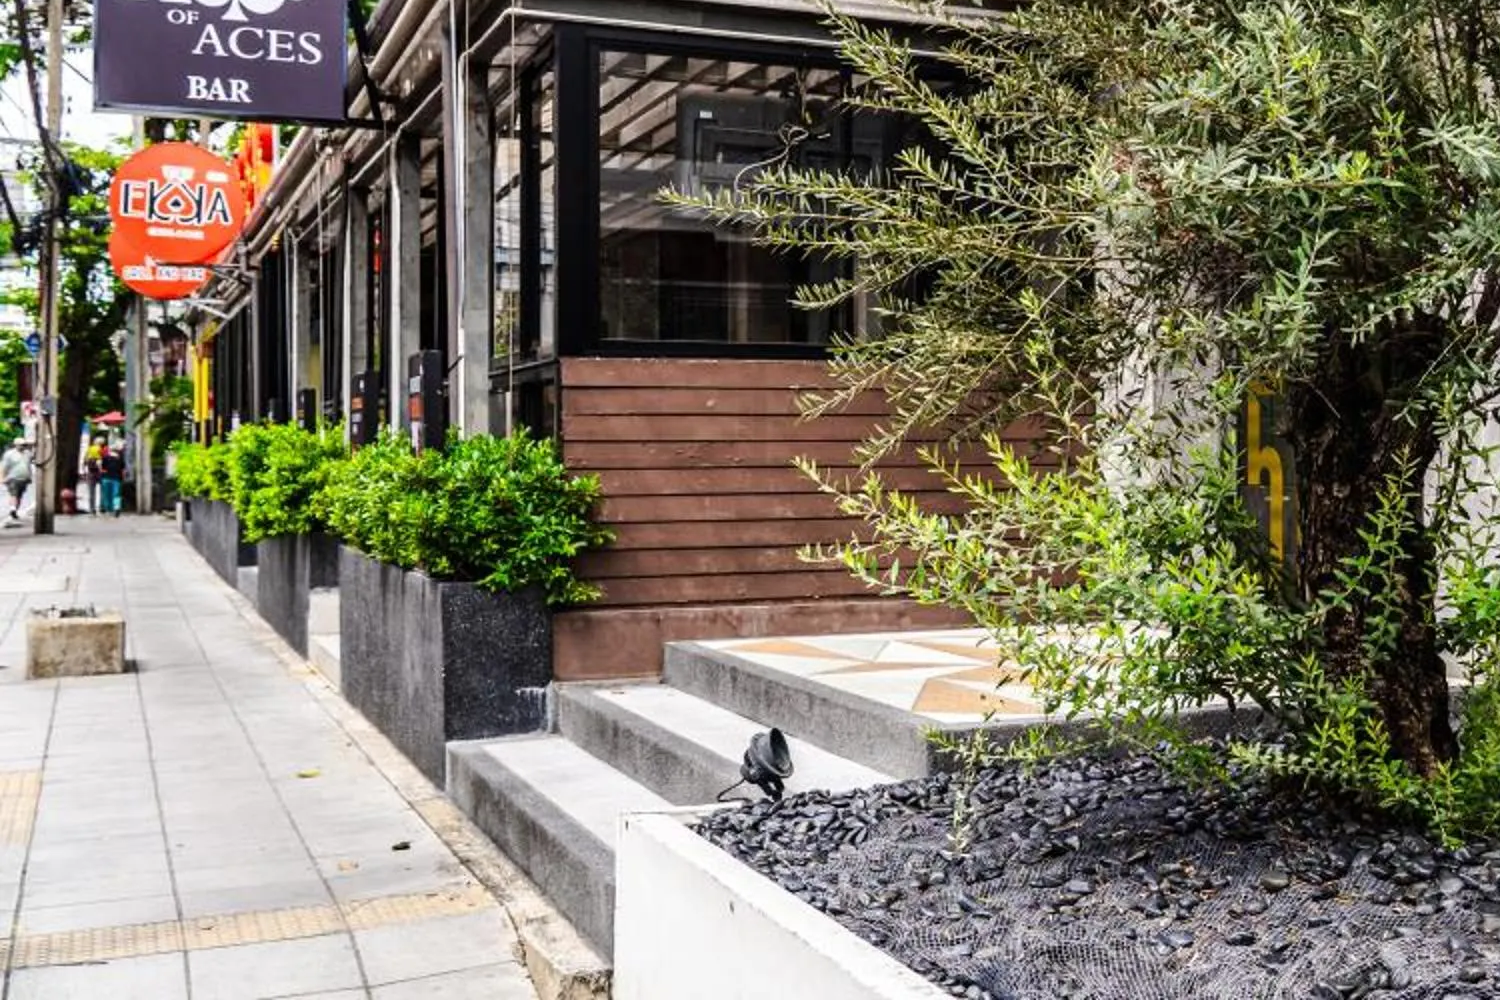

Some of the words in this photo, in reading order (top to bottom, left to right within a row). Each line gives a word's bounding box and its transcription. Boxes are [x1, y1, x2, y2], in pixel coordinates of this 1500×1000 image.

[167, 9, 199, 25] OF
[192, 24, 322, 65] ACES
[187, 75, 252, 103] BAR
